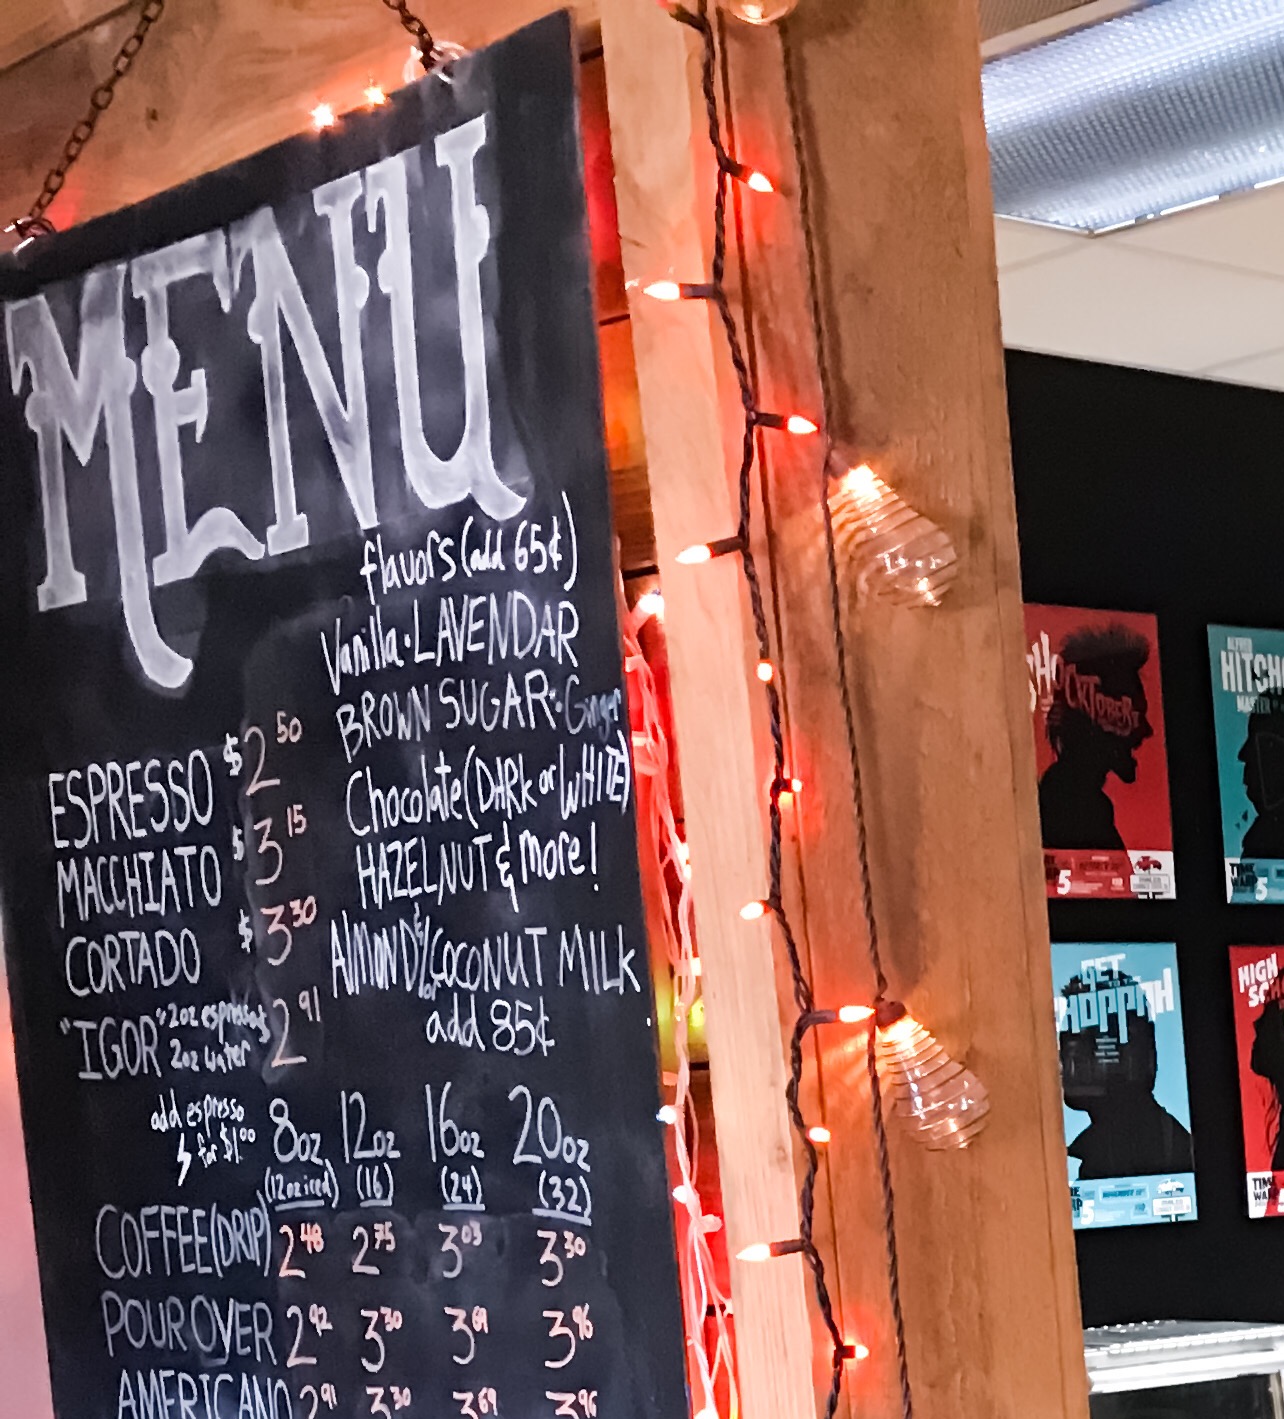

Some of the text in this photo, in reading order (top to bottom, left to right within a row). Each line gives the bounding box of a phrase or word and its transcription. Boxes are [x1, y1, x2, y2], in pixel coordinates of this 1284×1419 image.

[5, 114, 527, 688] MENU
[360, 532, 456, 605] flavors
[414, 590, 580, 668] LAVENDAR
[336, 683, 431, 763] BROWN
[48, 749, 213, 849] ESPRESSO
[346, 750, 462, 836] Chocolate
[538, 765, 556, 795] or
[56, 845, 222, 928] MACCHIATO
[356, 834, 492, 909] HAZELNUT
[519, 821, 599, 891] more!
[1255, 877, 1269, 901] 5
[65, 927, 200, 997] CORTADO
[559, 923, 641, 995] MILK
[1238, 953, 1278, 993] HIGH
[426, 993, 485, 1051] add
[151, 1088, 245, 1138] add espresso
[269, 1081, 591, 1172] 8oz 12oz 16oz 20oz
[95, 1204, 212, 1279] COFFEE
[1081, 1200, 1095, 1225] 5
